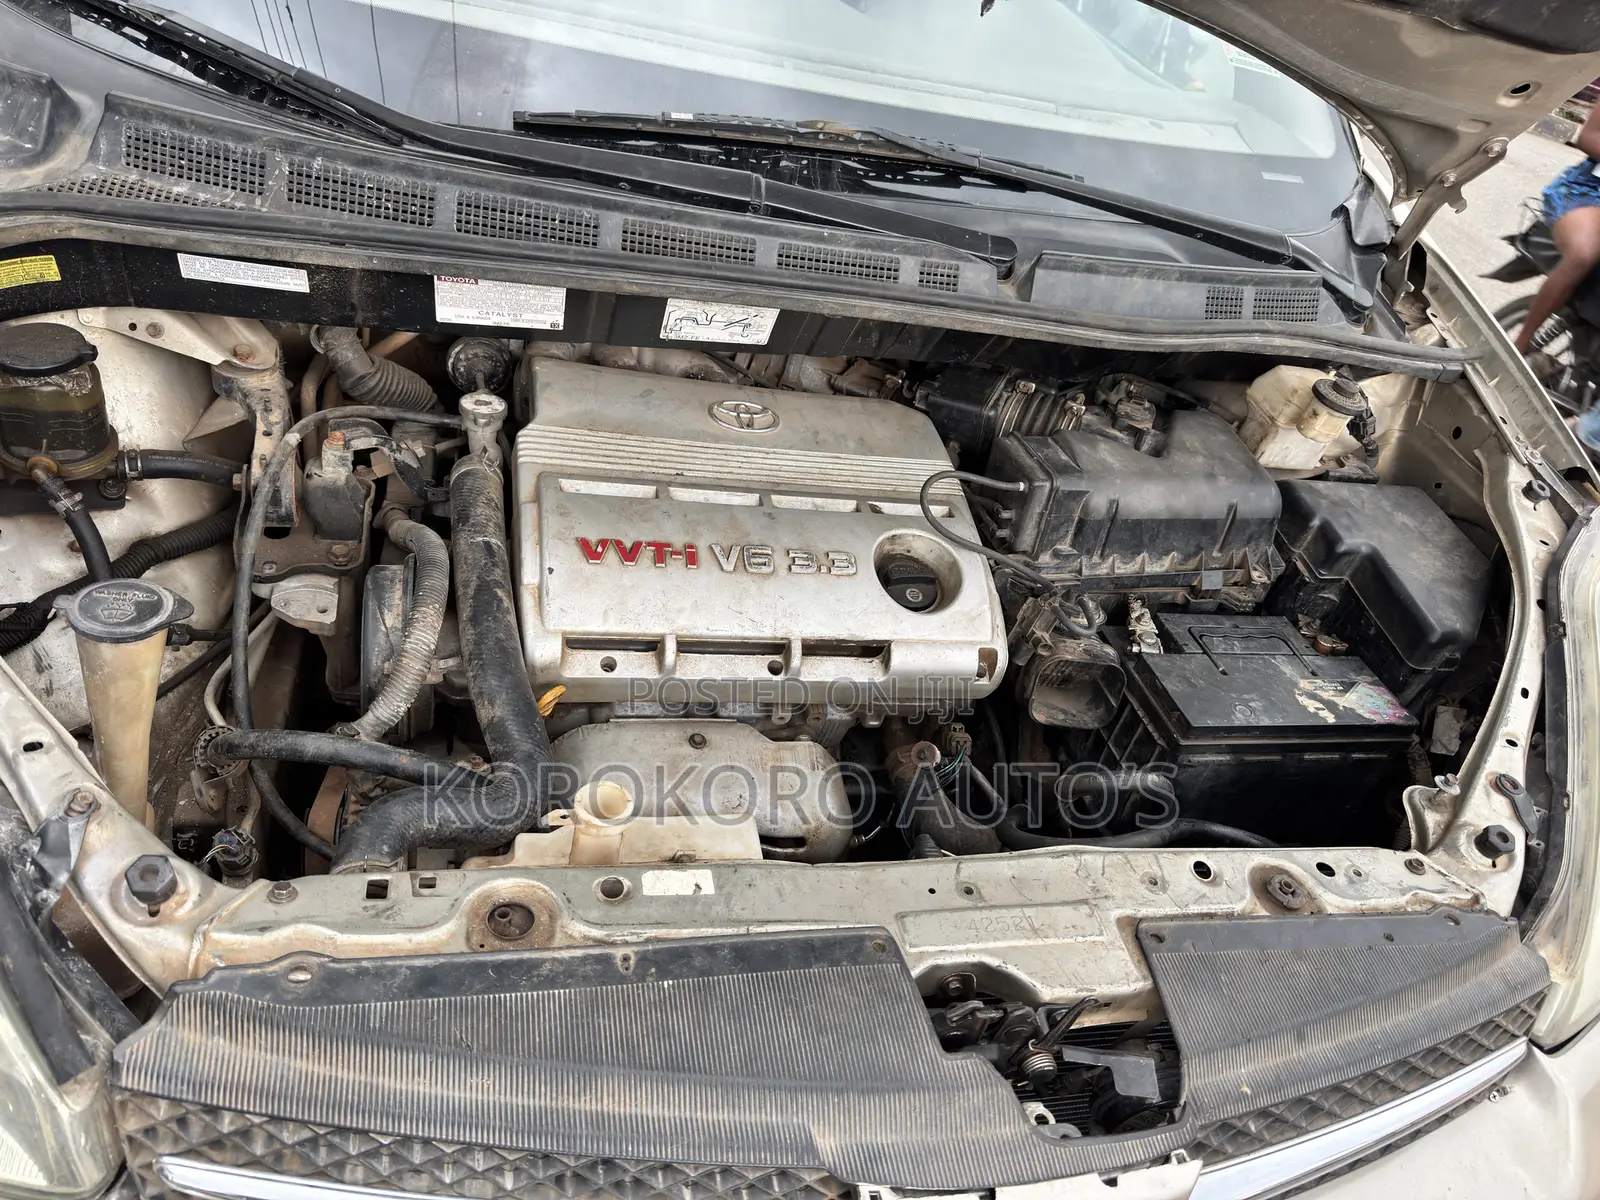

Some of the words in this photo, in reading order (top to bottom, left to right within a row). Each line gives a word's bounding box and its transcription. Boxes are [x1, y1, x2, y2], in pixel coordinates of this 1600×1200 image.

[440, 275, 476, 284] TOYOTA
[478, 310, 524, 319] CATALYST
[709, 542, 776, 574] V6
[786, 548, 858, 576] 3.3
[94, 590, 128, 598] WASHER
